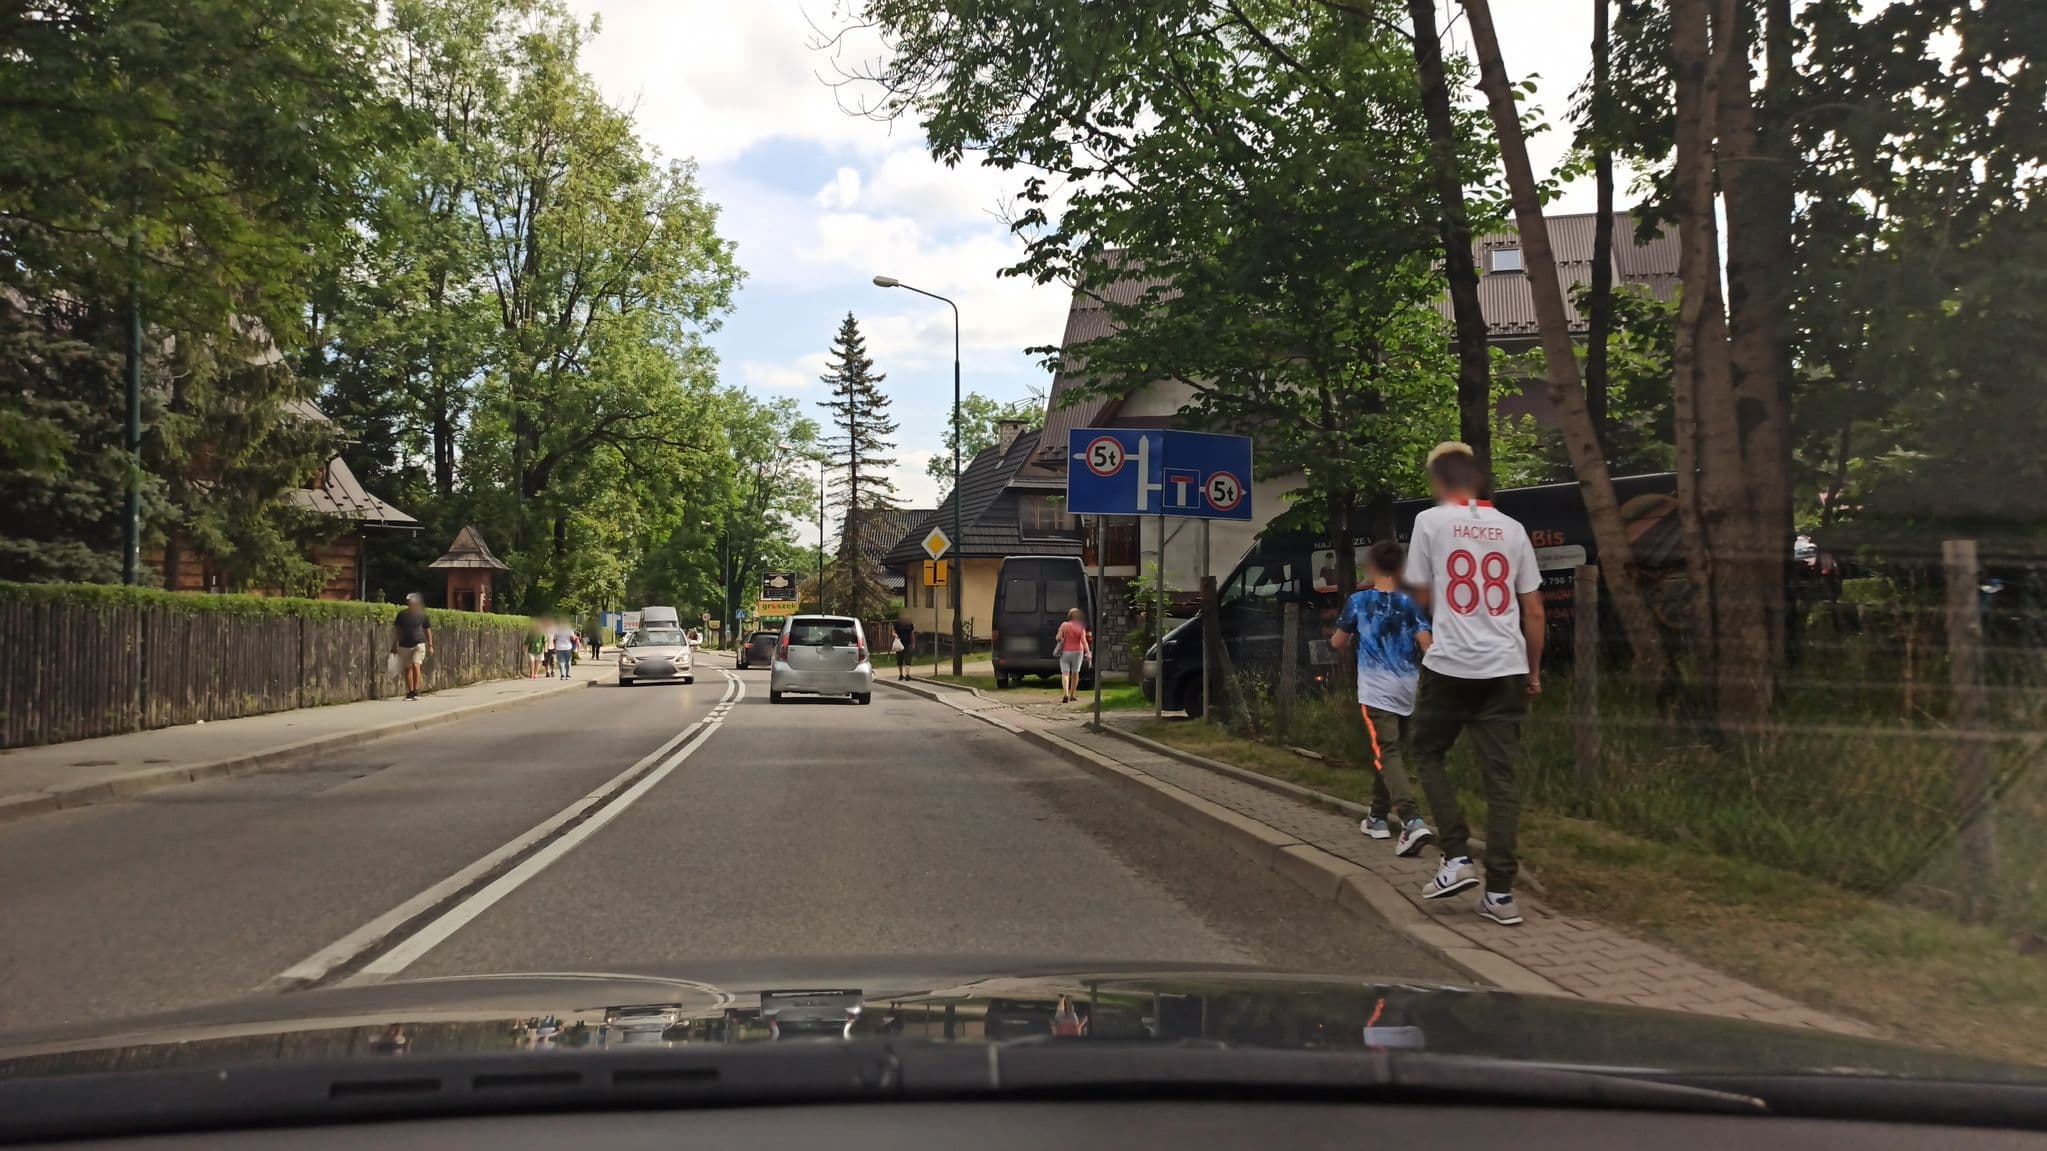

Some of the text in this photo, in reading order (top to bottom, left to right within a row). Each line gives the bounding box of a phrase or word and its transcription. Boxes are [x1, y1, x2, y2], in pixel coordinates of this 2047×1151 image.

[1094, 446, 1116, 467] 5t
[1214, 481, 1234, 502] 5t
[1453, 525, 1504, 541] HACKER
[1446, 549, 1510, 617] 88
